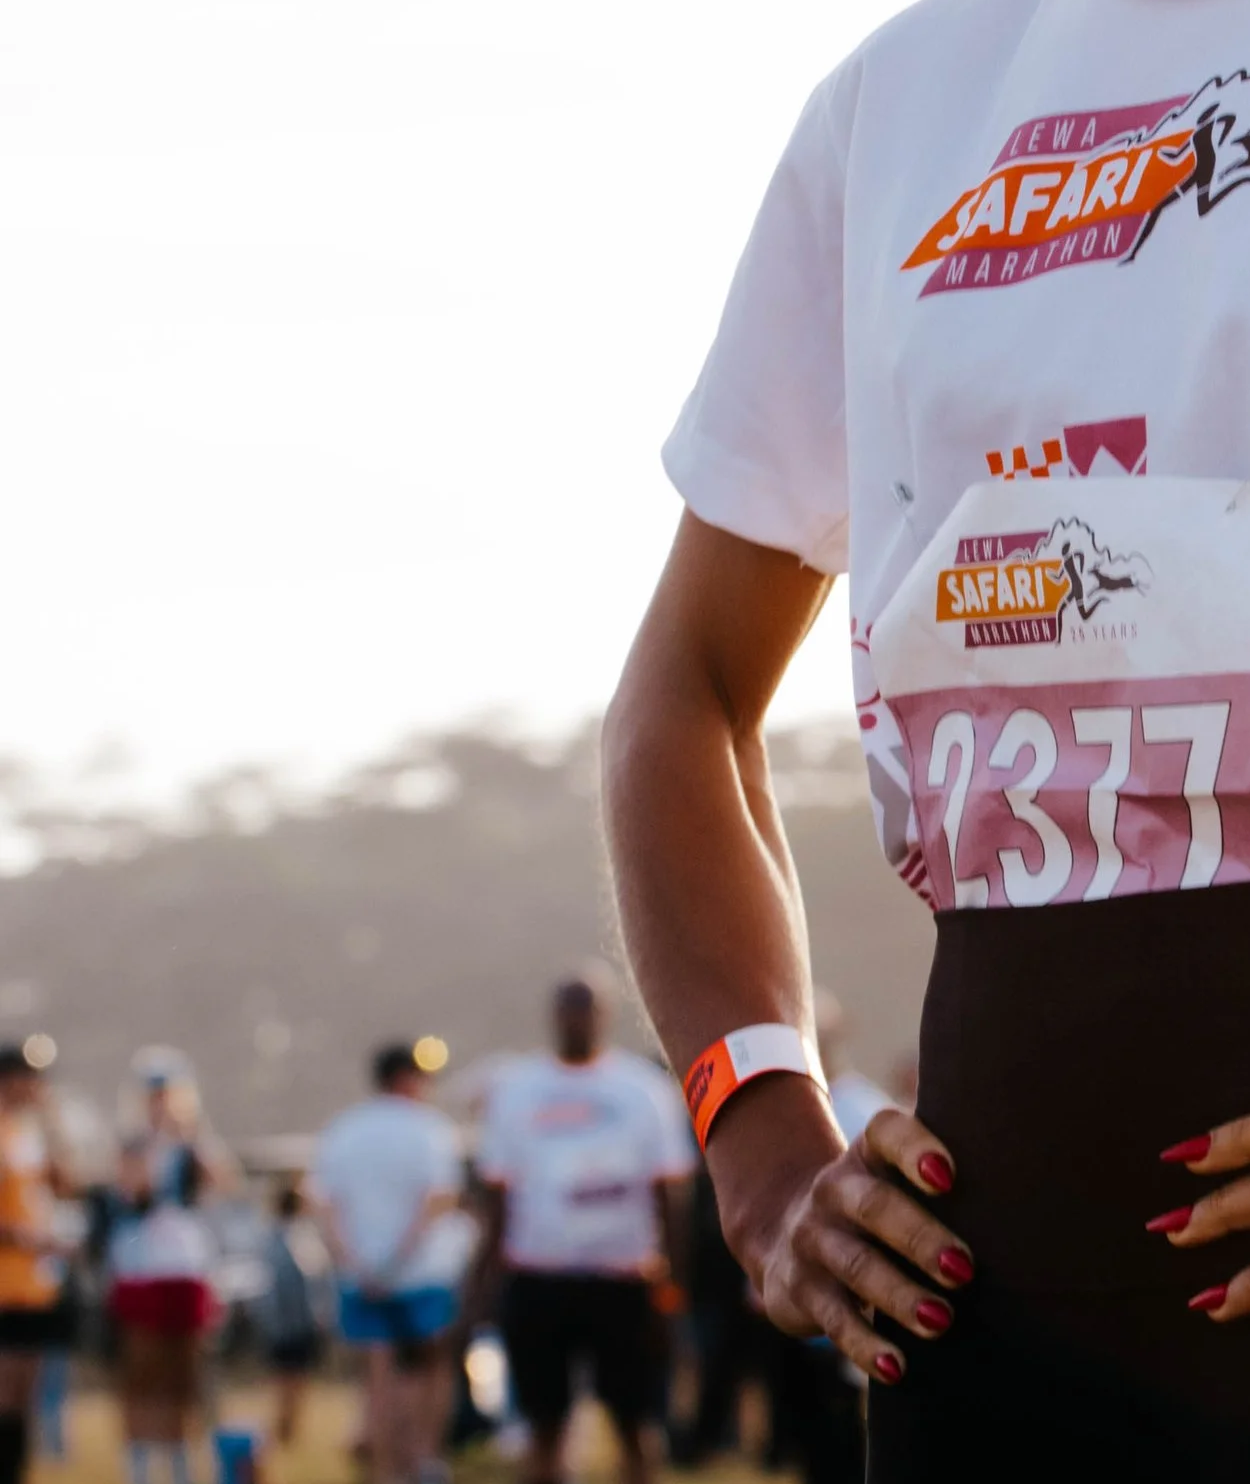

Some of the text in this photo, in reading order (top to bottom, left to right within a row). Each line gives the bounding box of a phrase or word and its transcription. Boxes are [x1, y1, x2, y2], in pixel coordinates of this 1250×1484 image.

[1010, 117, 1096, 156] LEWA
[938, 148, 1153, 250] SAFARI
[945, 221, 1122, 285] MARATHON
[963, 538, 1004, 562] LEWA
[946, 566, 1045, 614] SAFARI
[970, 619, 1051, 644] MARATHON
[927, 701, 1232, 910] 2377
